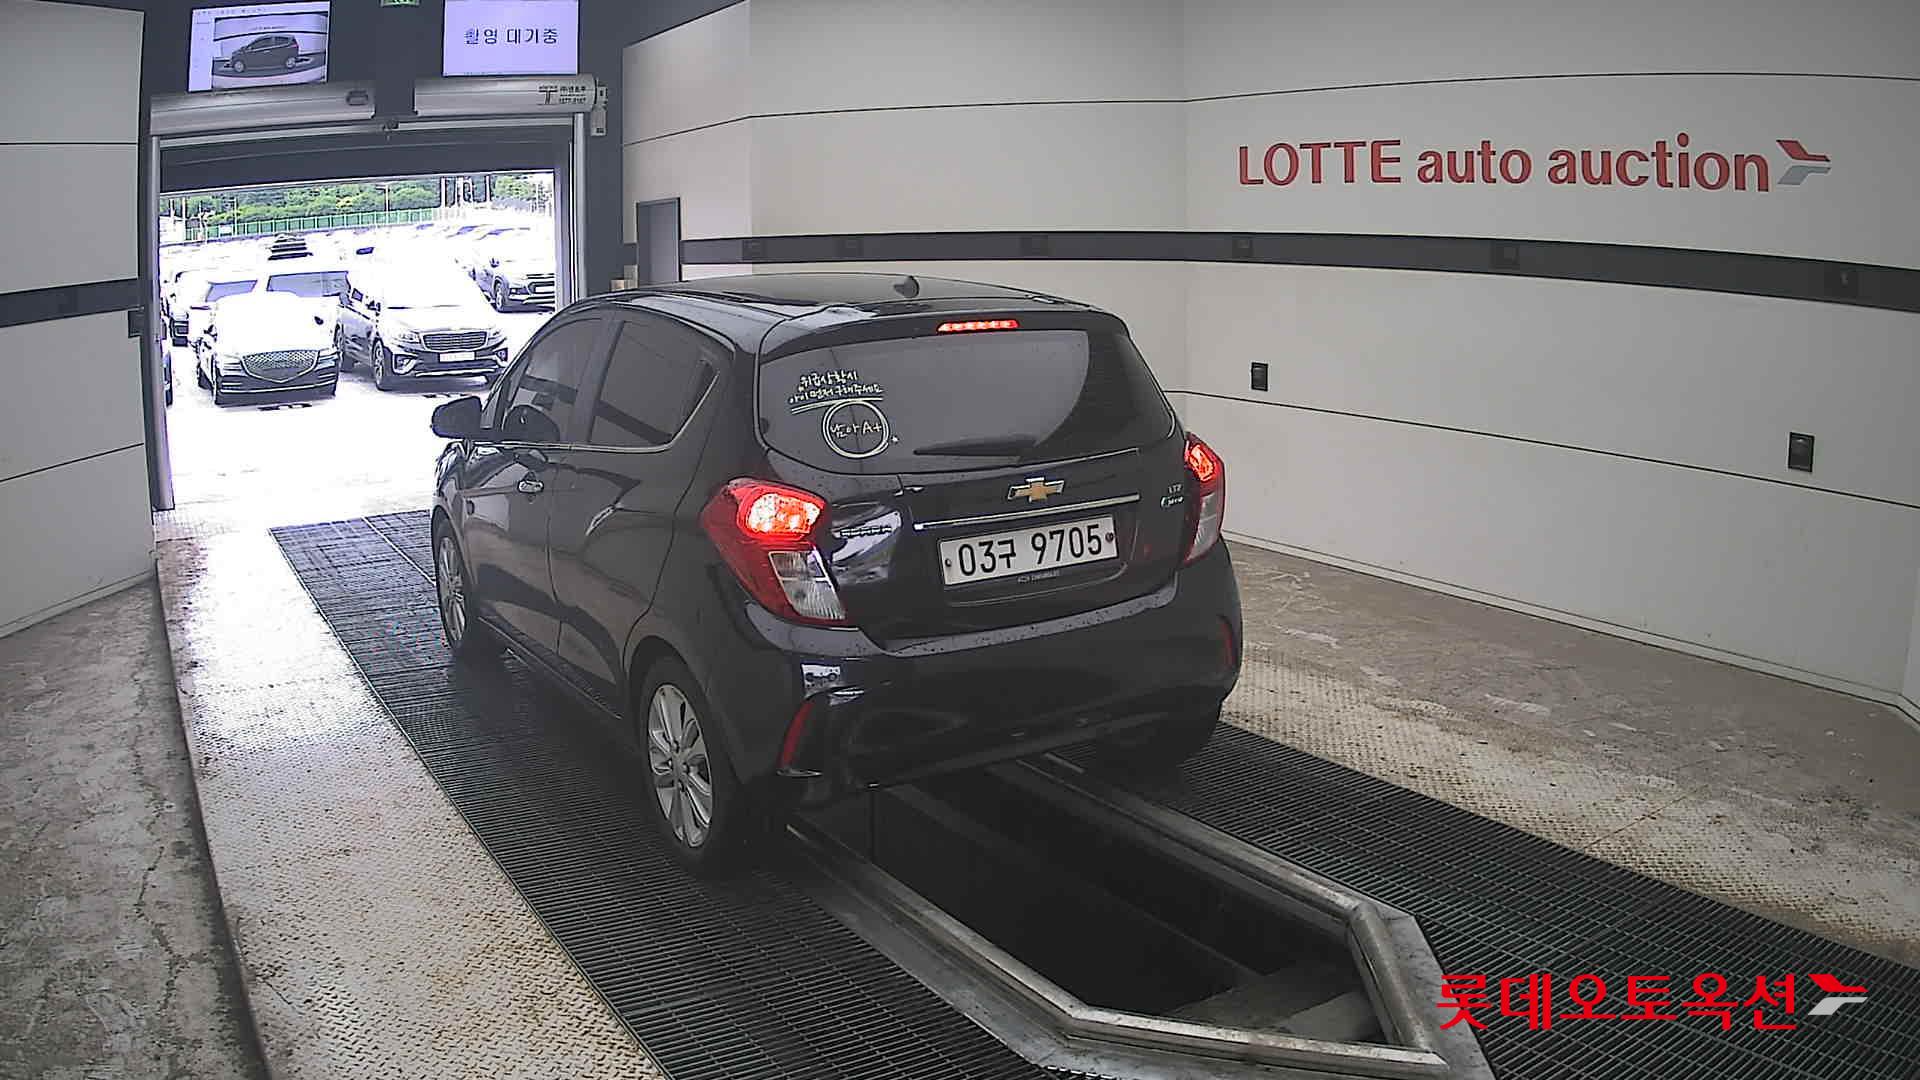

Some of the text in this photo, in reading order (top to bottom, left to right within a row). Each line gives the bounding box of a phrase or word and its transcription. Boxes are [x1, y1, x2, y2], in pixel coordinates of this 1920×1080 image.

[506, 28, 558, 45] 대기중
[1239, 132, 1769, 192] LOTTE auto auction
[958, 523, 1102, 576] 03구 9705
